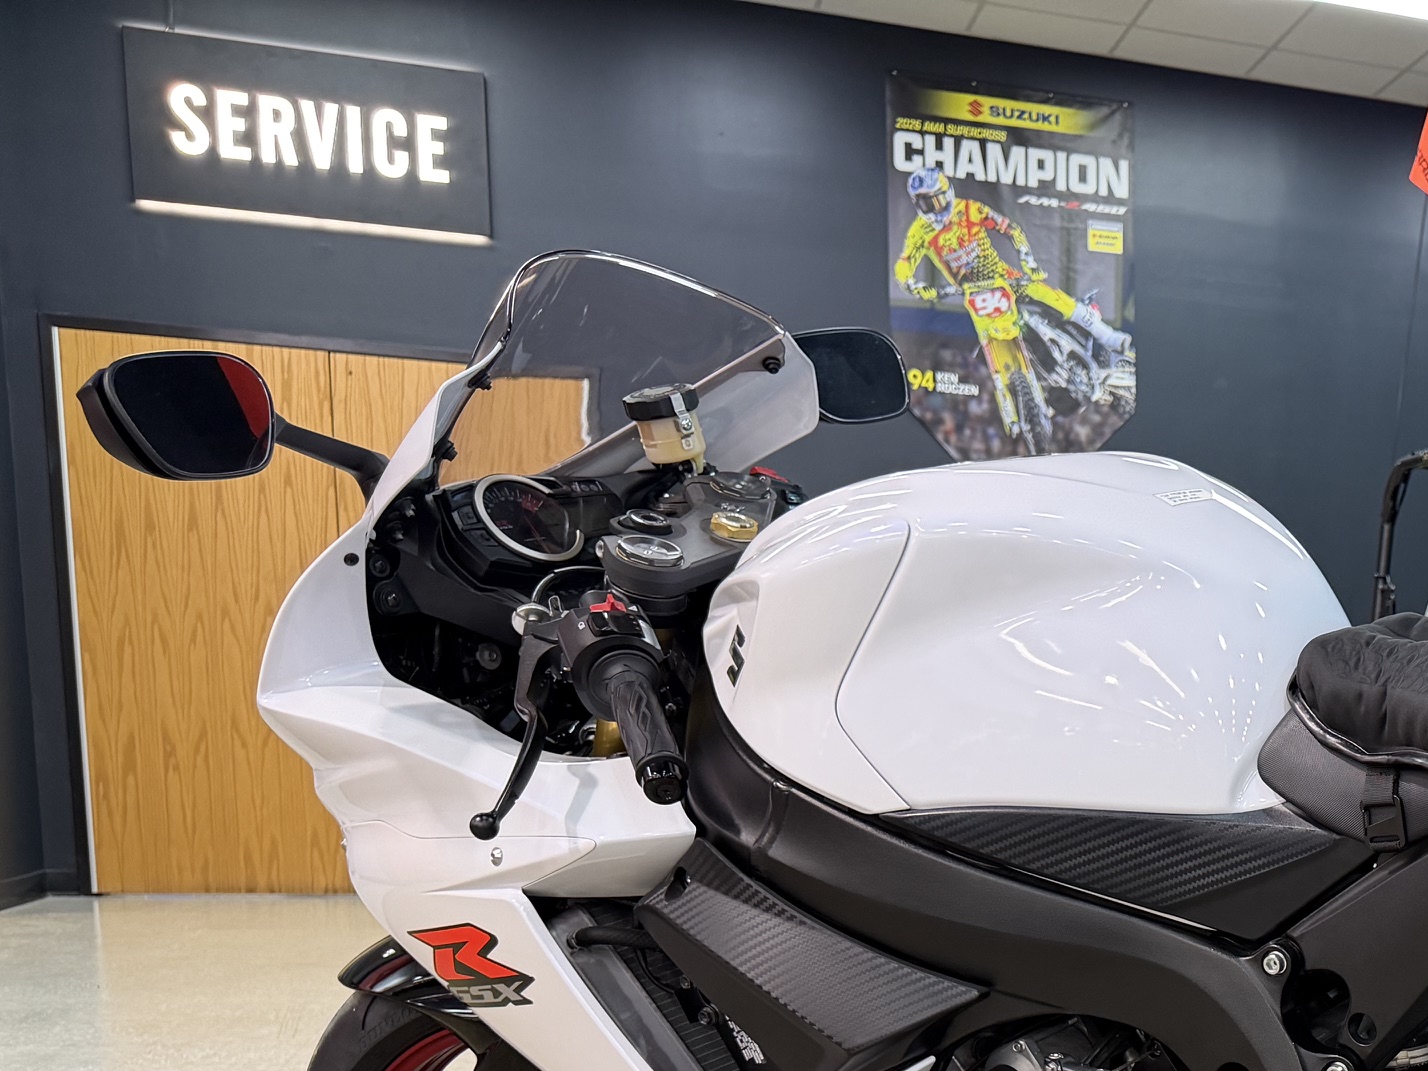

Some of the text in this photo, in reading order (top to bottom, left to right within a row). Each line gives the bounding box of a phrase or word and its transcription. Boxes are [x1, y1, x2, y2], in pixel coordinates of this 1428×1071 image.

[988, 105, 1061, 126] SUZUKI
[166, 82, 452, 184] SERVICE
[922, 120, 945, 133] AMA
[946, 123, 1008, 142] SUPERCROSS
[892, 131, 1129, 199] CHAMPION
[974, 292, 1012, 317] 94
[907, 368, 935, 392] 94
